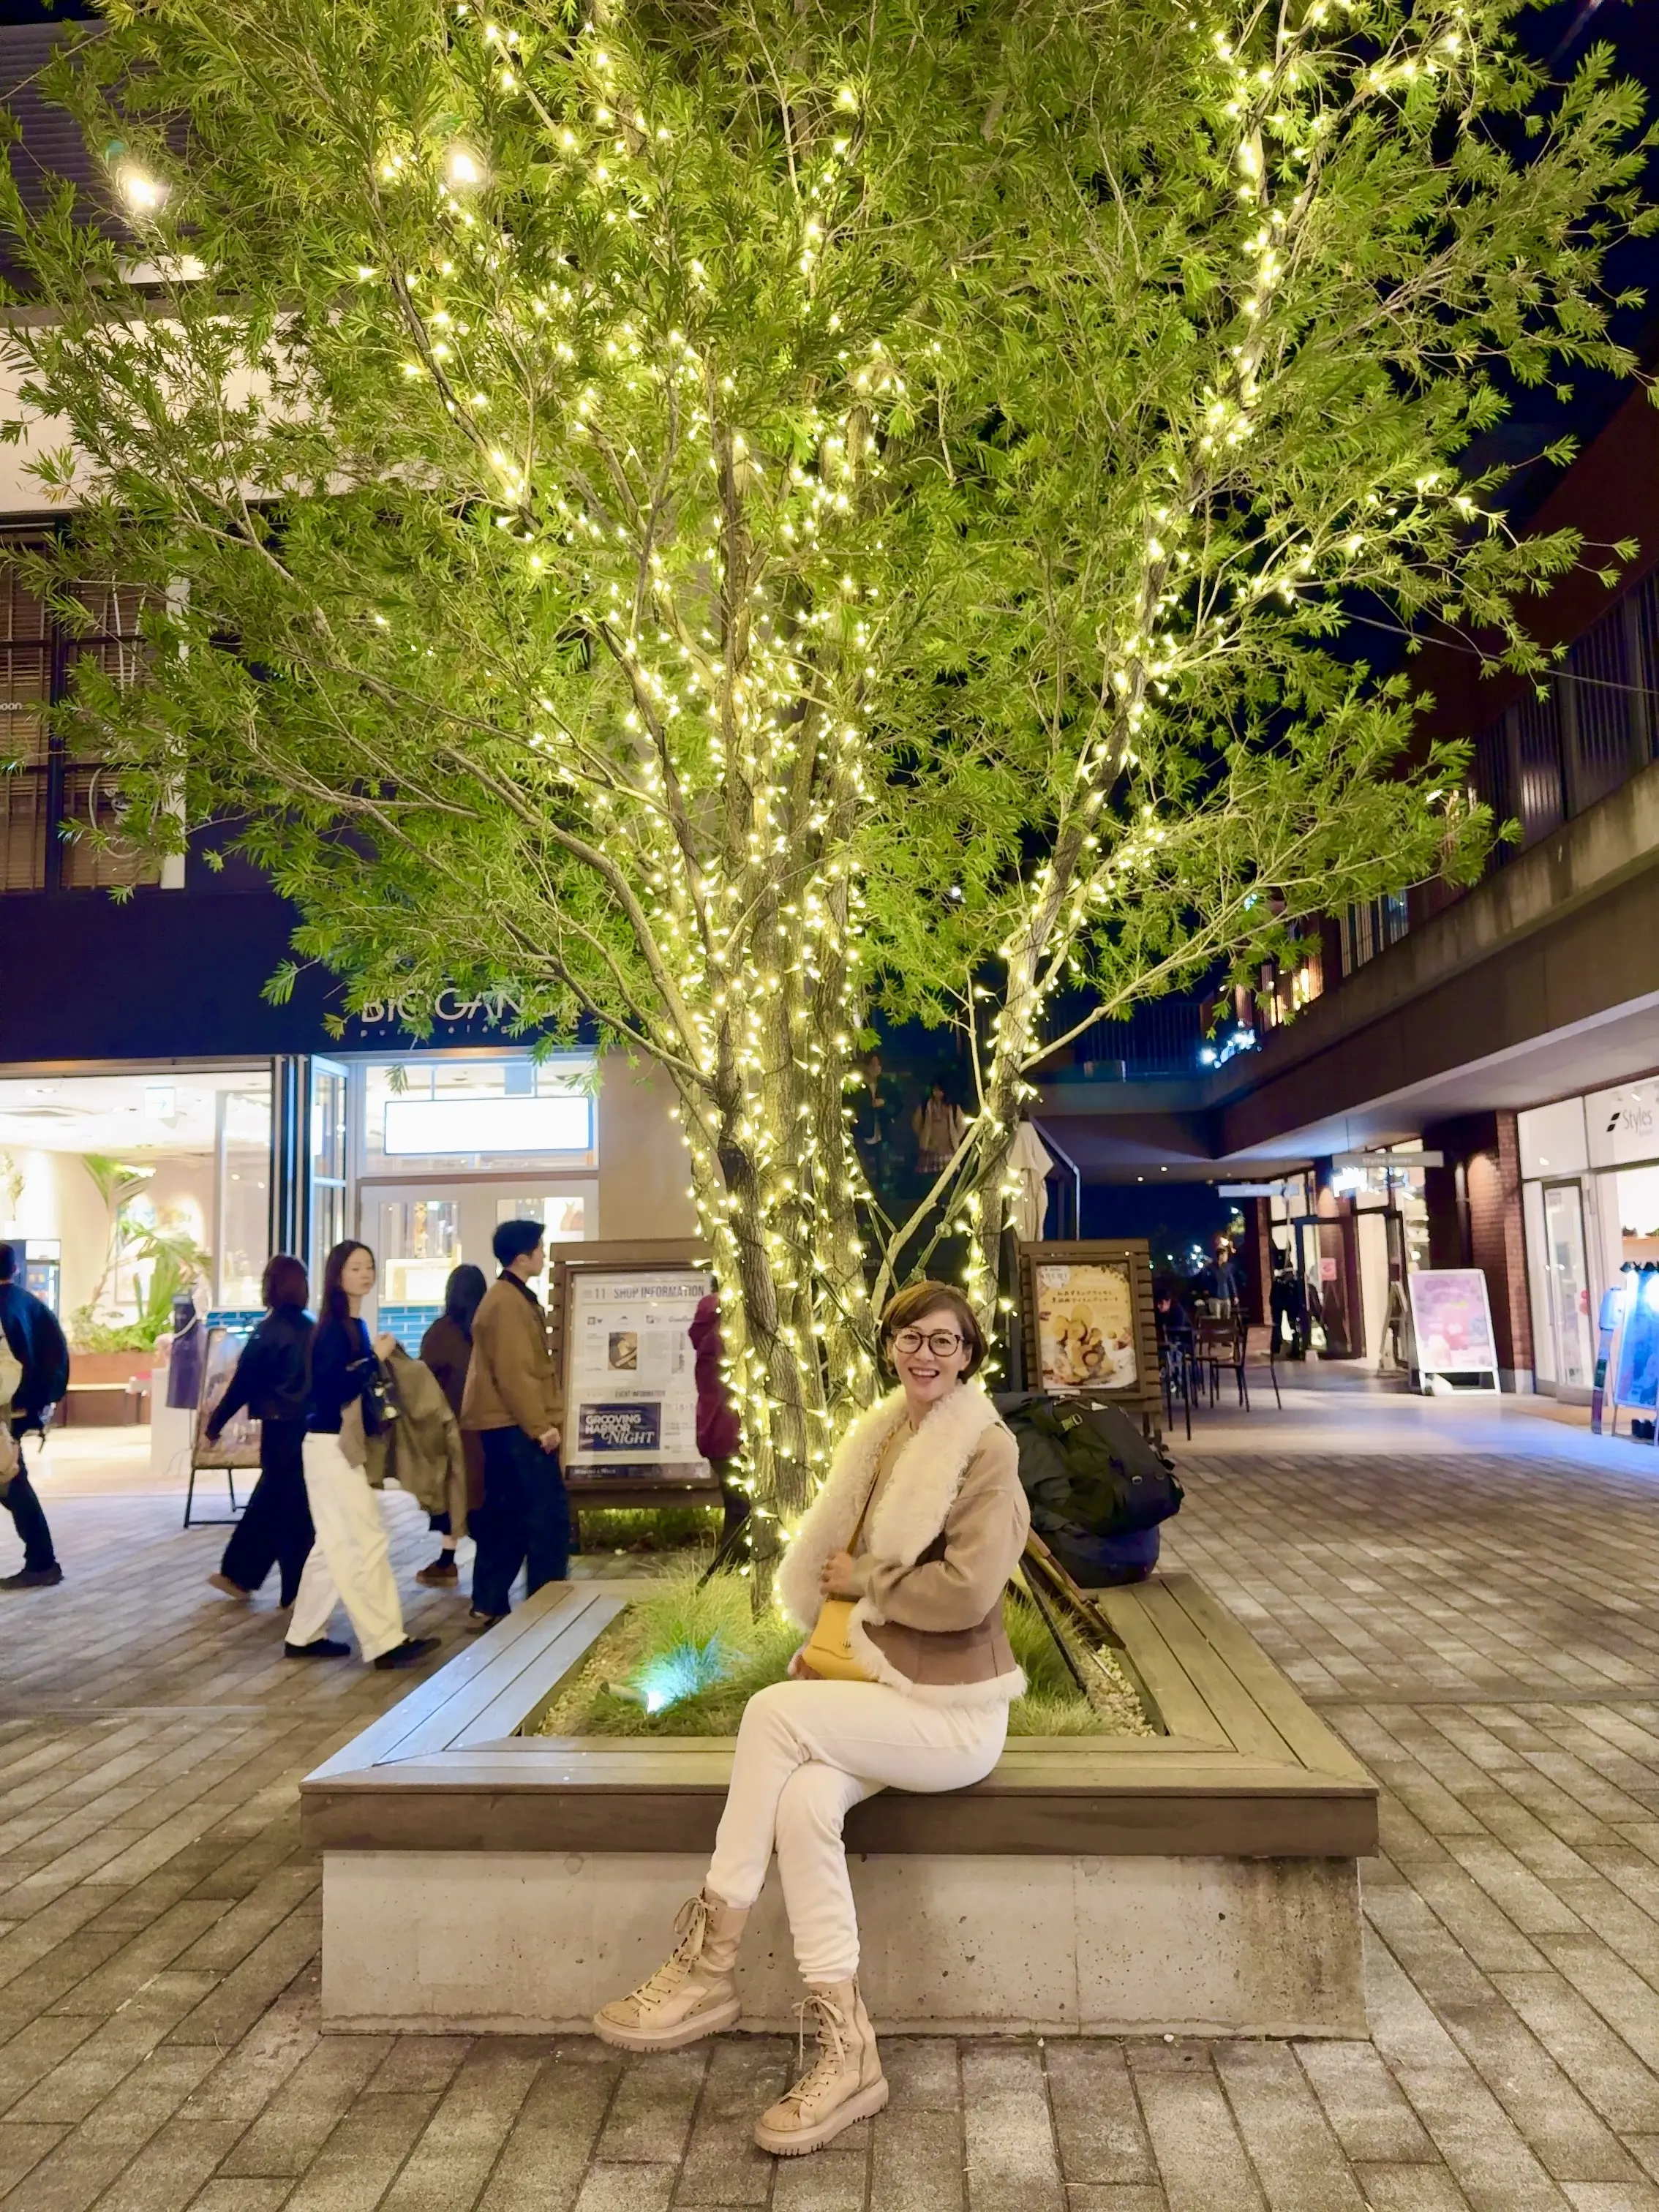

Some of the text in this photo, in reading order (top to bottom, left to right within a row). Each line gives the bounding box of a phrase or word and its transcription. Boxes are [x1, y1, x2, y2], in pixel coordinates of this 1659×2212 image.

[1622, 1105, 1652, 1134] Styles
[614, 1287, 639, 1299] SHOP
[641, 1285, 705, 1298] INFORMATION
[585, 1413, 642, 1425] GROOVING
